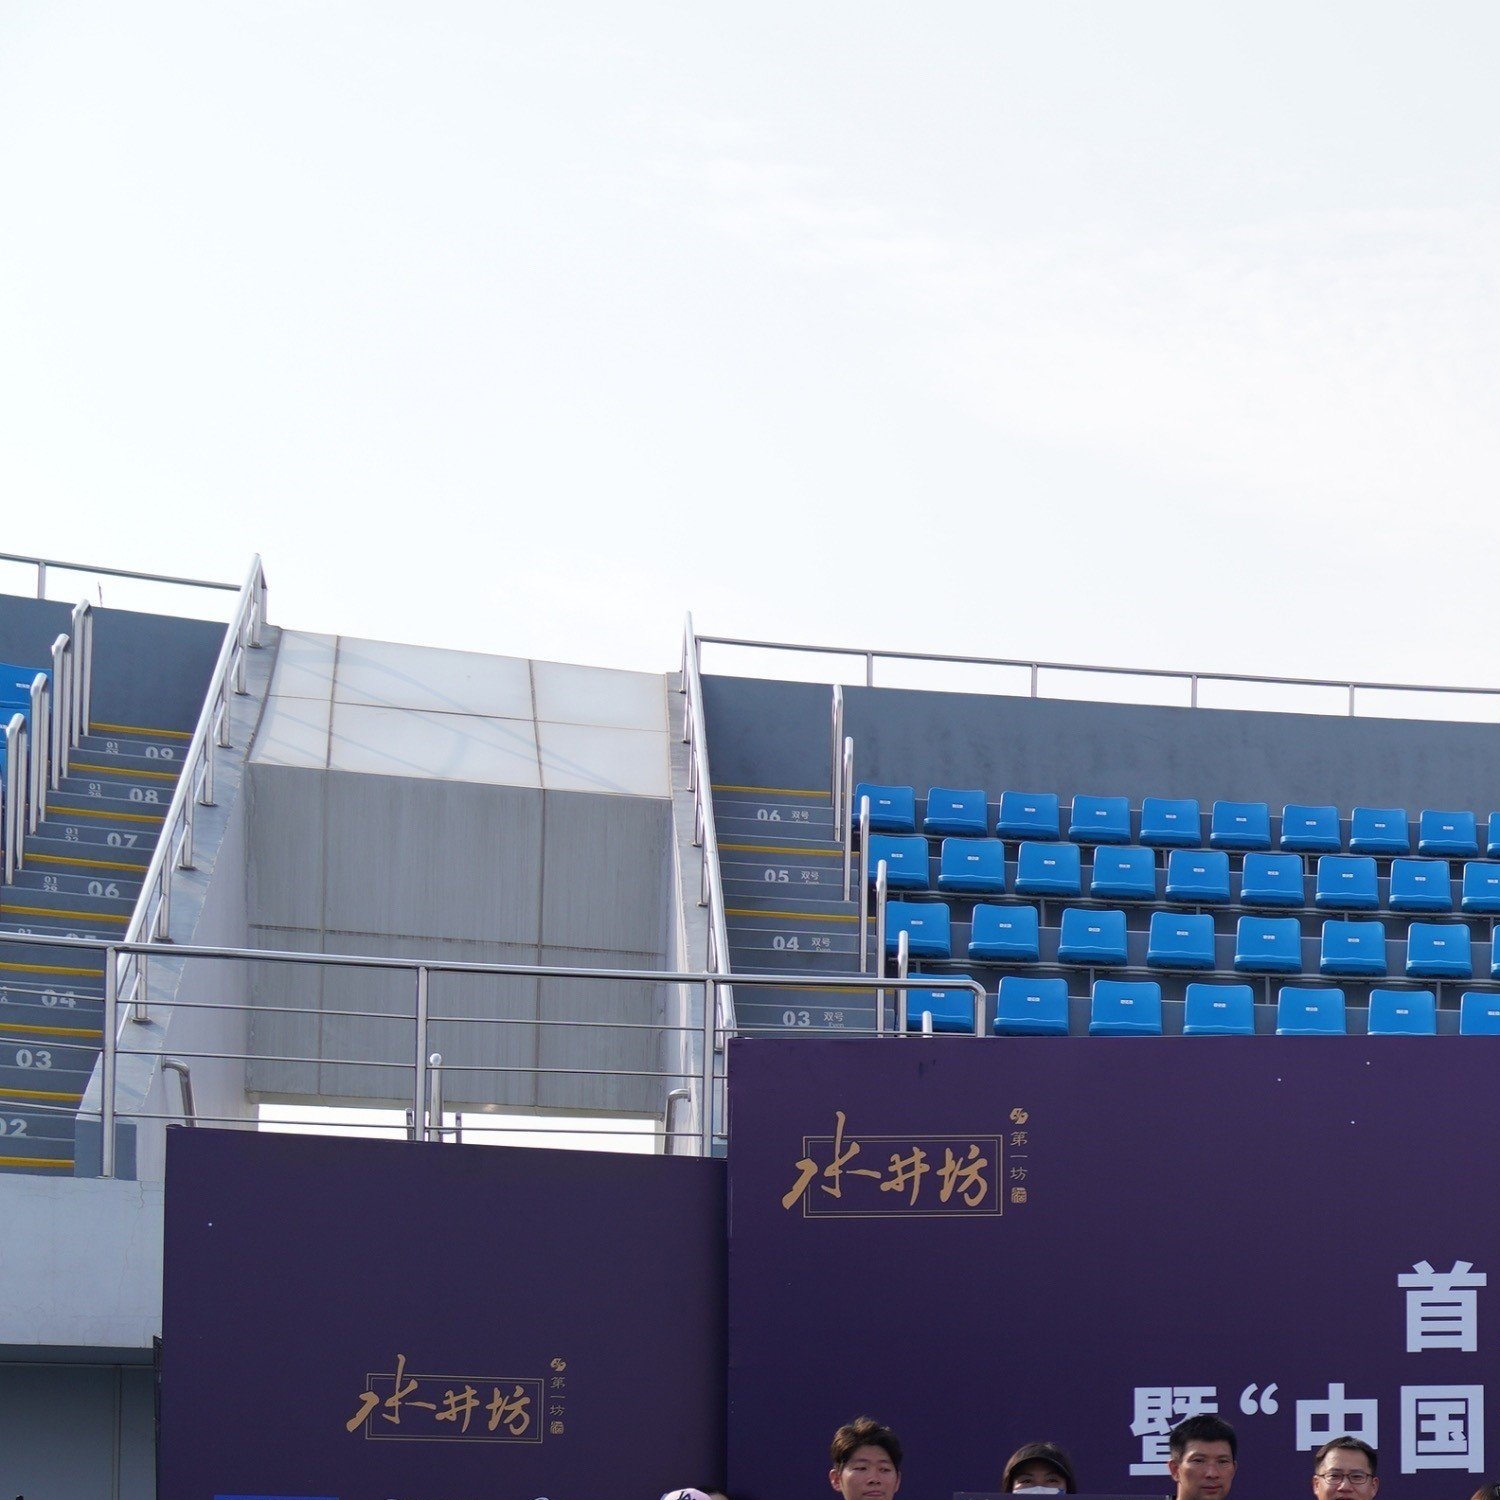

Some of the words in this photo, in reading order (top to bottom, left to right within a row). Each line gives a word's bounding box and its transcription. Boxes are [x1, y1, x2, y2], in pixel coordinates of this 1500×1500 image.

[129, 788, 159, 803] 08
[757, 809, 781, 821] 06
[107, 832, 138, 848] 07
[764, 869, 789, 883] 05
[88, 881, 120, 898] 06
[773, 936, 799, 950] 04
[783, 1011, 811, 1027] 03
[16, 1049, 52, 1069] 03
[1010, 1130, 1029, 1181] 第一坊
